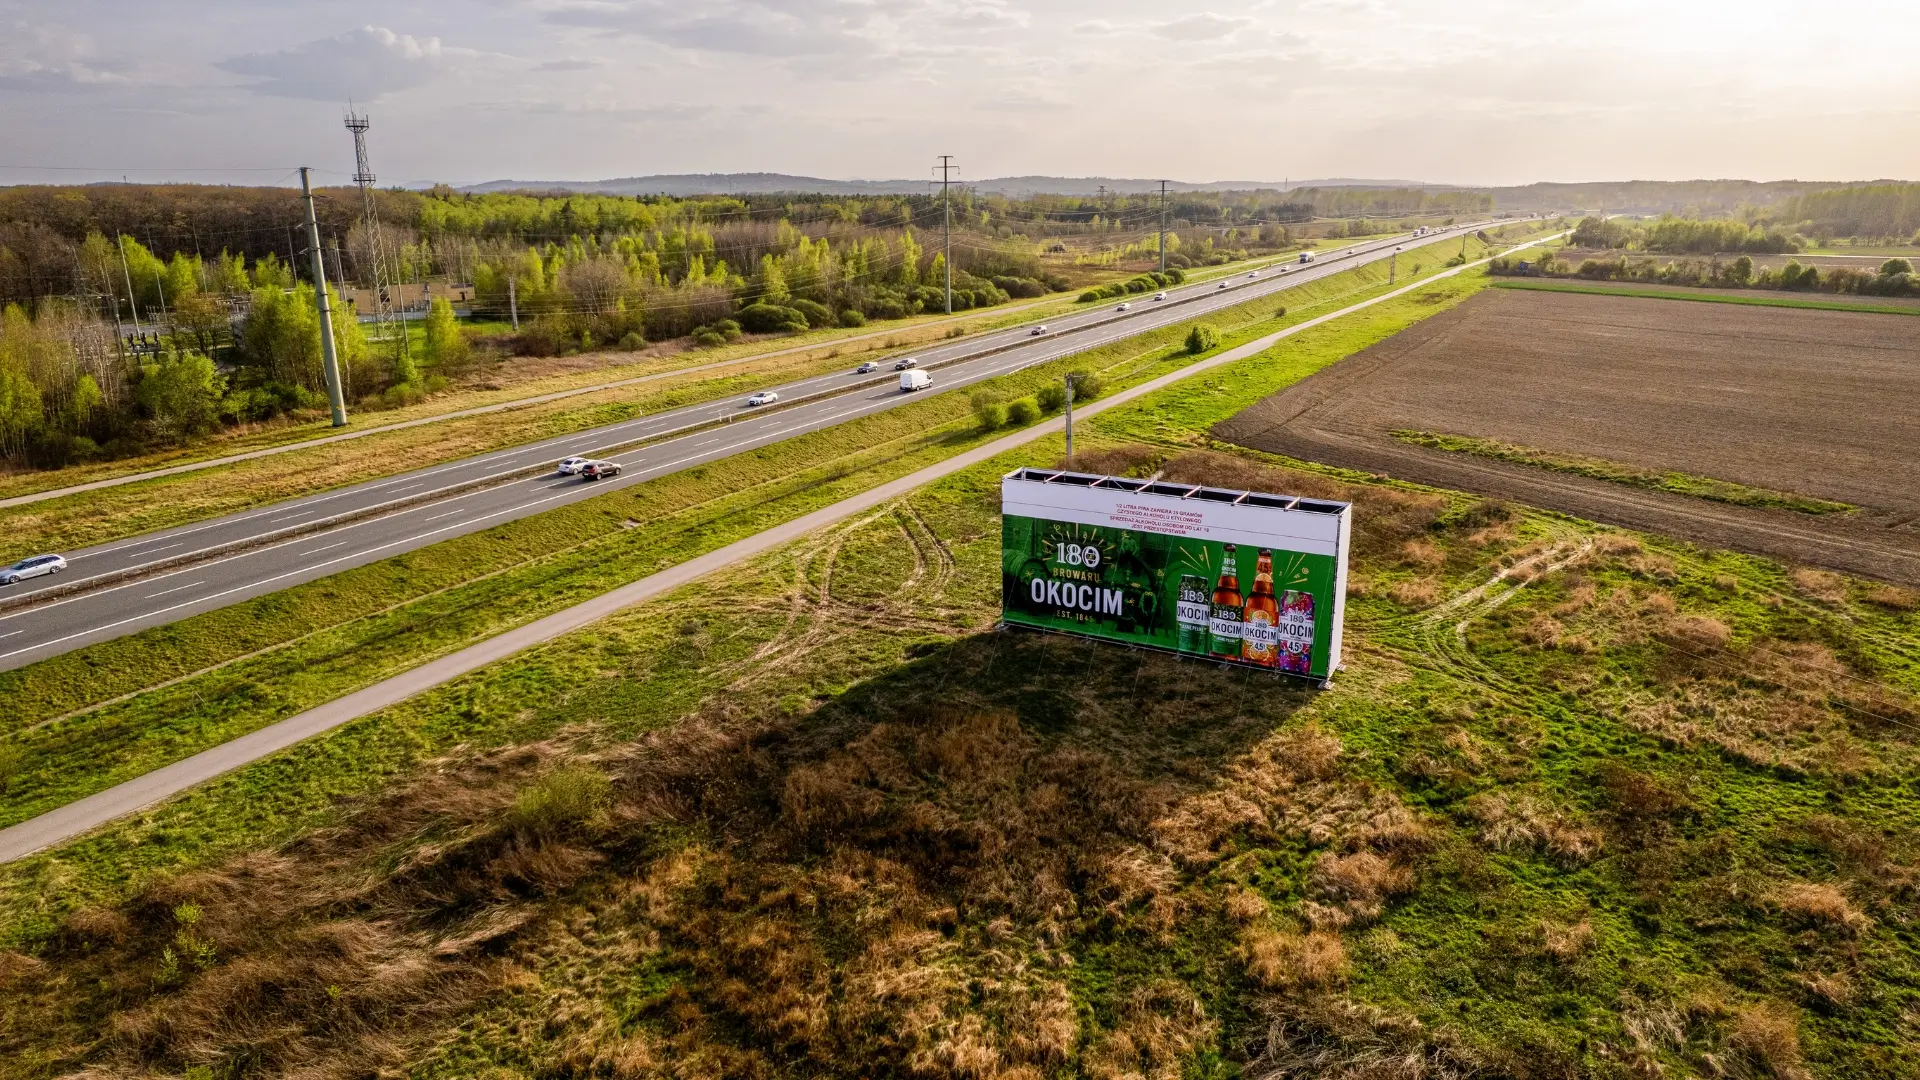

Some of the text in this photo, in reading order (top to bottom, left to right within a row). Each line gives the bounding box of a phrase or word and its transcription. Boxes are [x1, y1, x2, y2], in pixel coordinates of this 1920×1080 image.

[1143, 512, 1170, 520] ALKOHOLU
[1171, 515, 1202, 524] ETYLOWEGO
[1056, 542, 1100, 568] 180
[1053, 567, 1101, 583] BROWARU
[1031, 577, 1123, 616] OKOCIM
[1183, 589, 1205, 603] 180
[1056, 610, 1094, 622] EST. 1845
[1218, 609, 1236, 620] 180
[1290, 614, 1304, 623] 180
[1211, 621, 1242, 635] OKOCIM
[1245, 627, 1277, 640] OKOCIM
